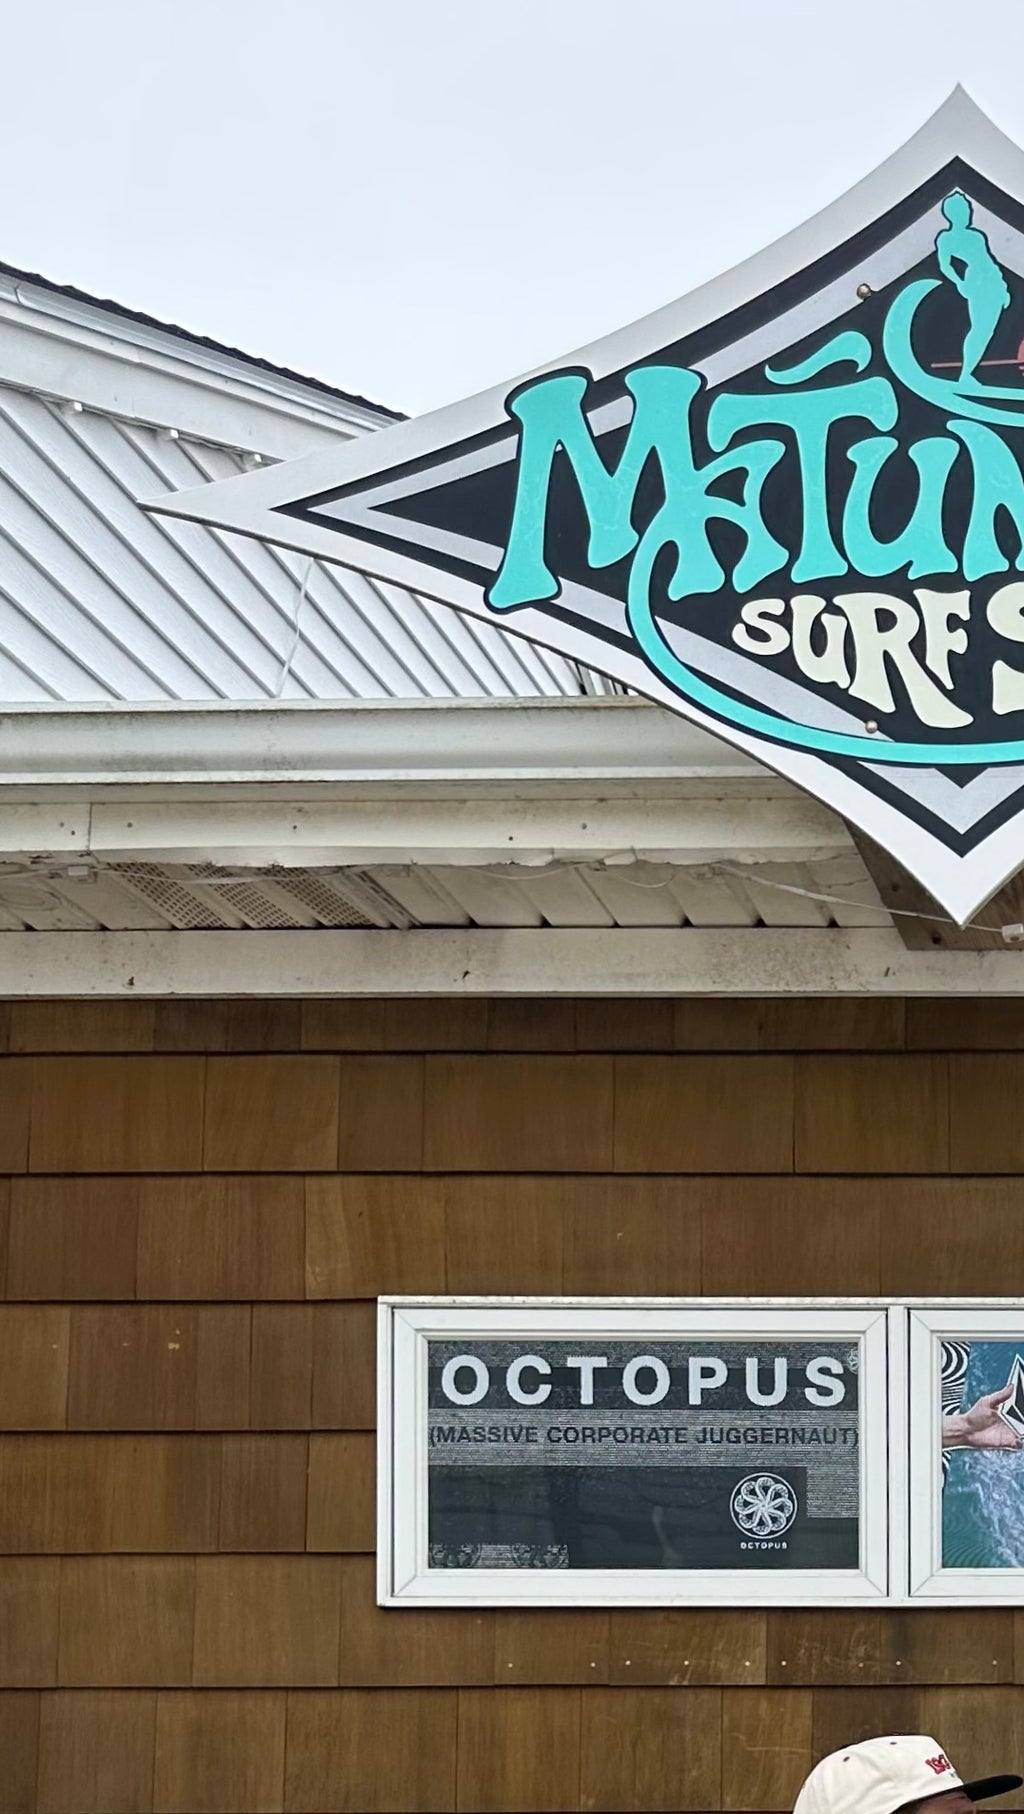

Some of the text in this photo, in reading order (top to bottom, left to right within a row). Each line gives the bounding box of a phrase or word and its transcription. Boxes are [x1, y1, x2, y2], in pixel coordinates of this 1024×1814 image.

[732, 592, 974, 728] SURF
[441, 1354, 846, 1407] OCTOPUS
[430, 1426, 859, 1447] (MASSIVE CORPORATE JUGGERNAUT)
